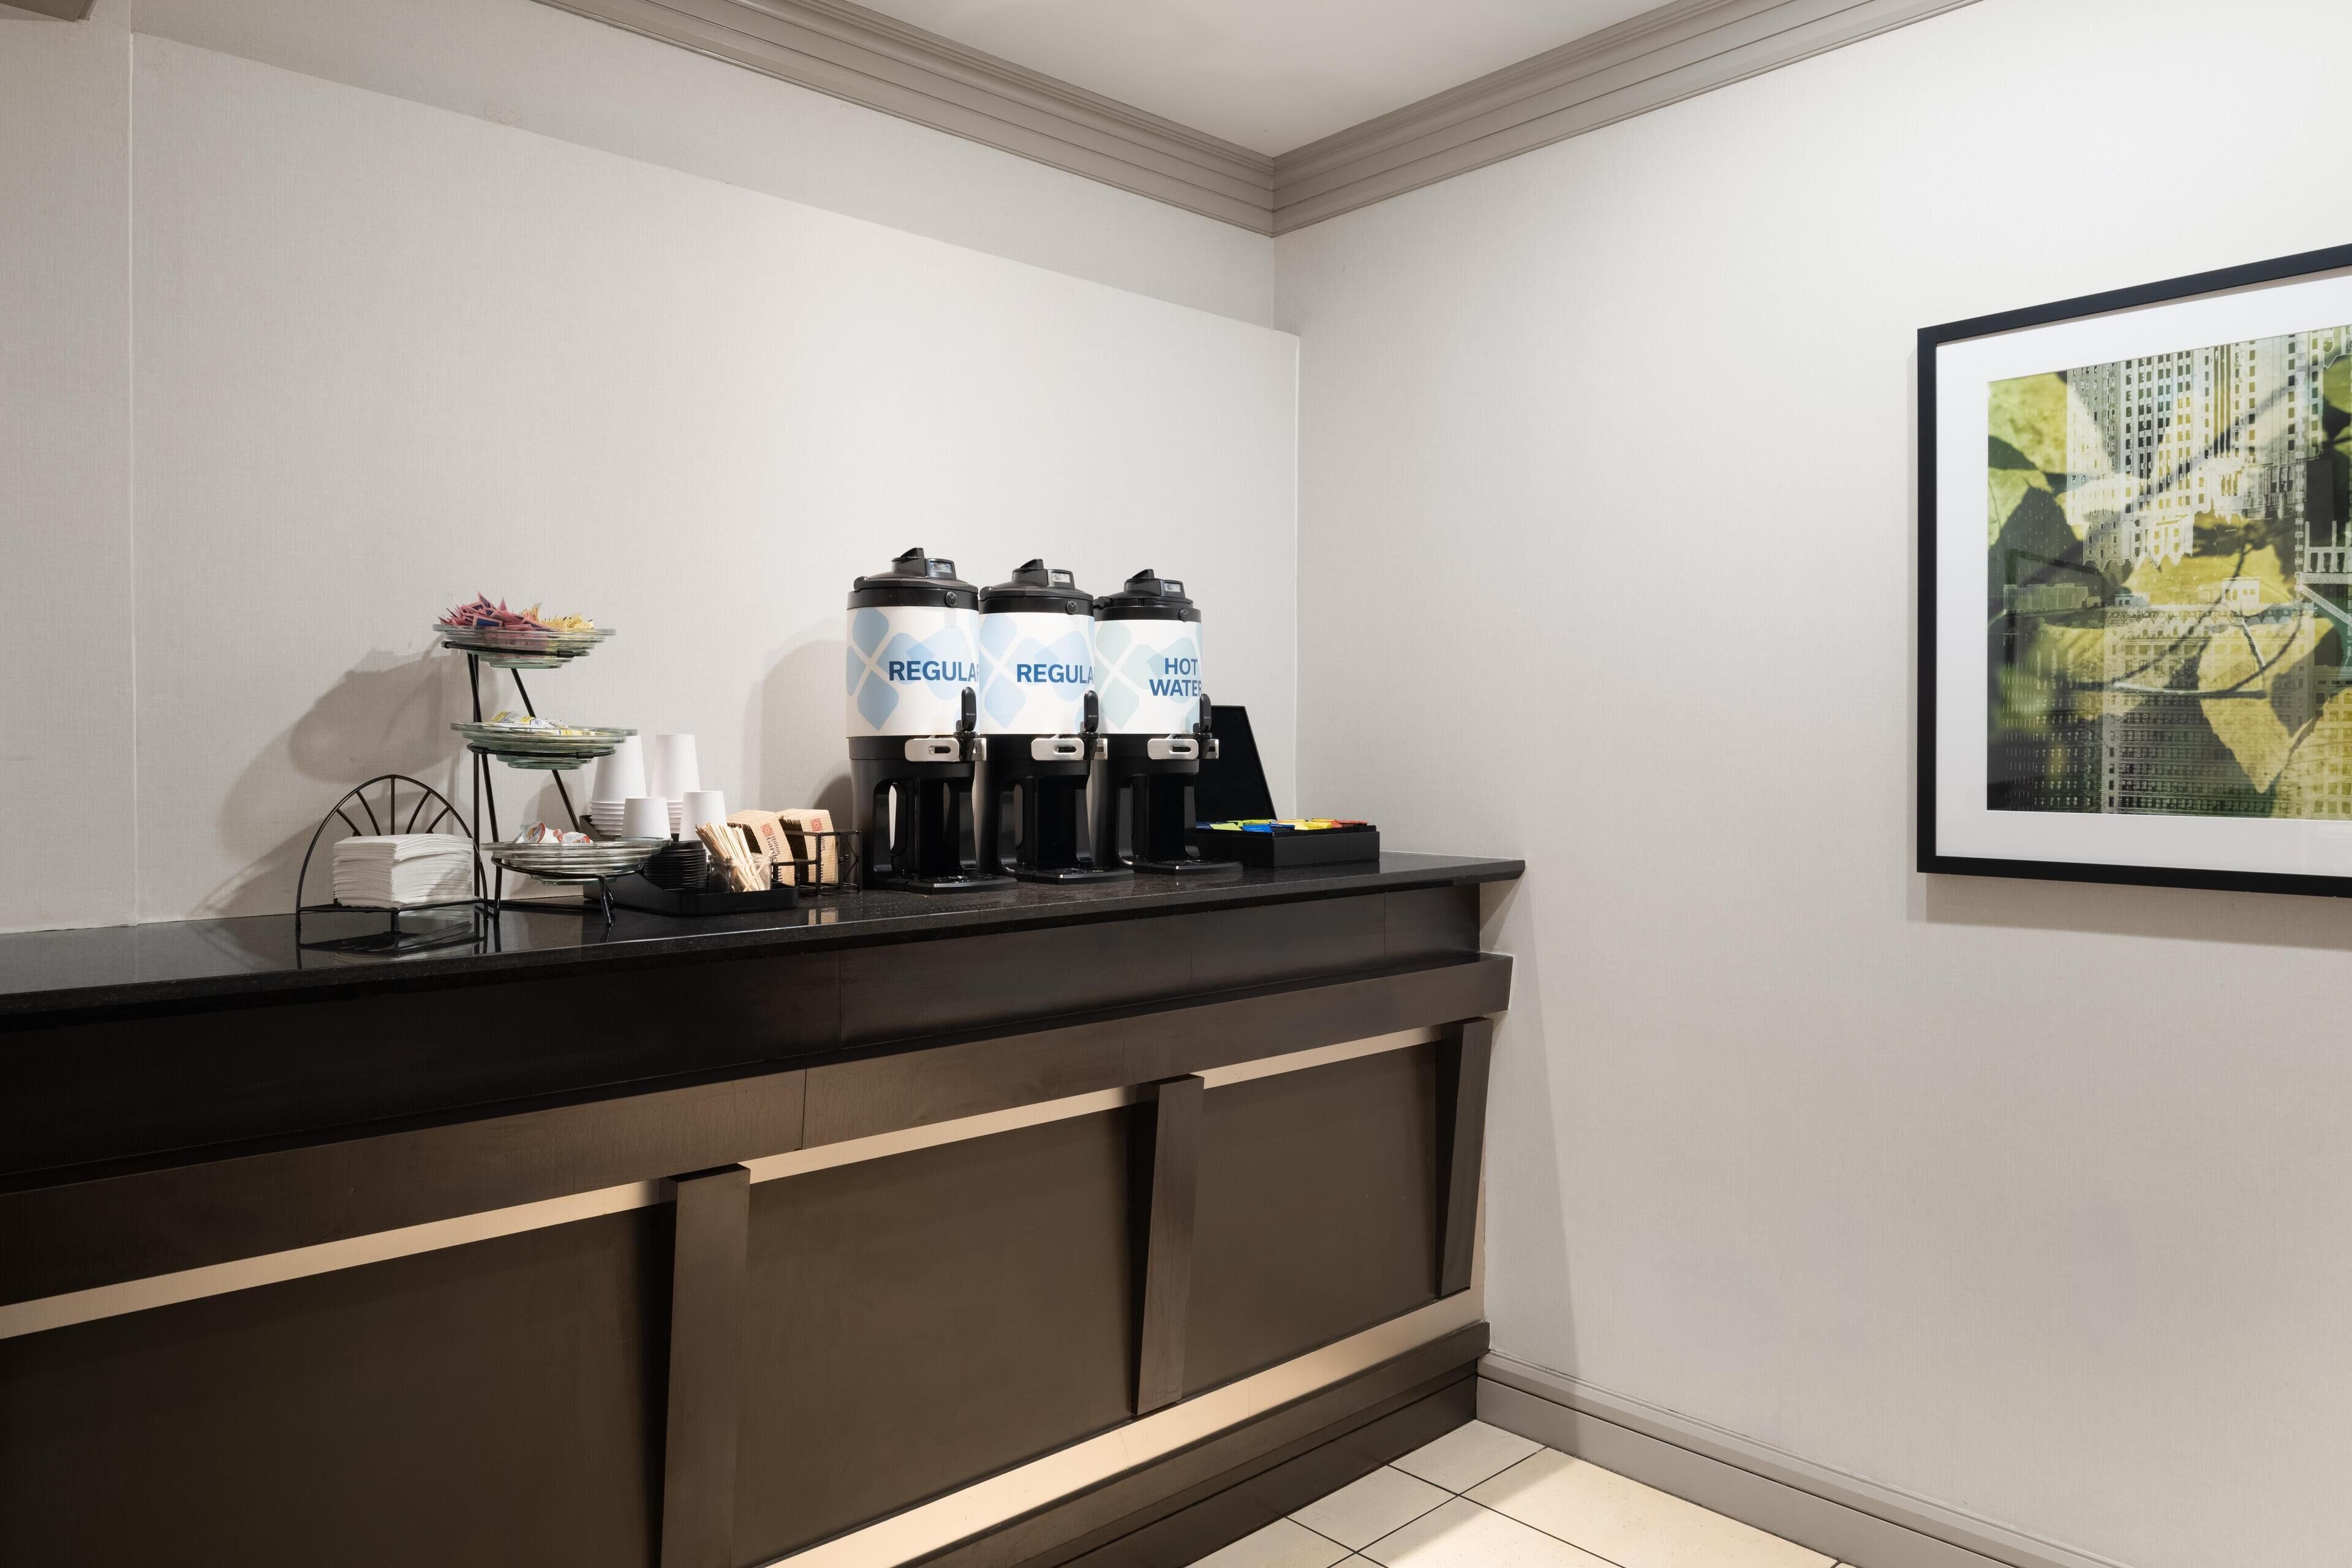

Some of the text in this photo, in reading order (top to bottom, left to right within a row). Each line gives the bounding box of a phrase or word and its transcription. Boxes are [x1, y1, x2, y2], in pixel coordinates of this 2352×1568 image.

[1017, 663, 1095, 684] REGULA
[1164, 657, 1198, 676] HOT
[1148, 679, 1202, 697] WATER
[766, 837, 778, 863] Garde
[771, 835, 781, 855] Hilton
